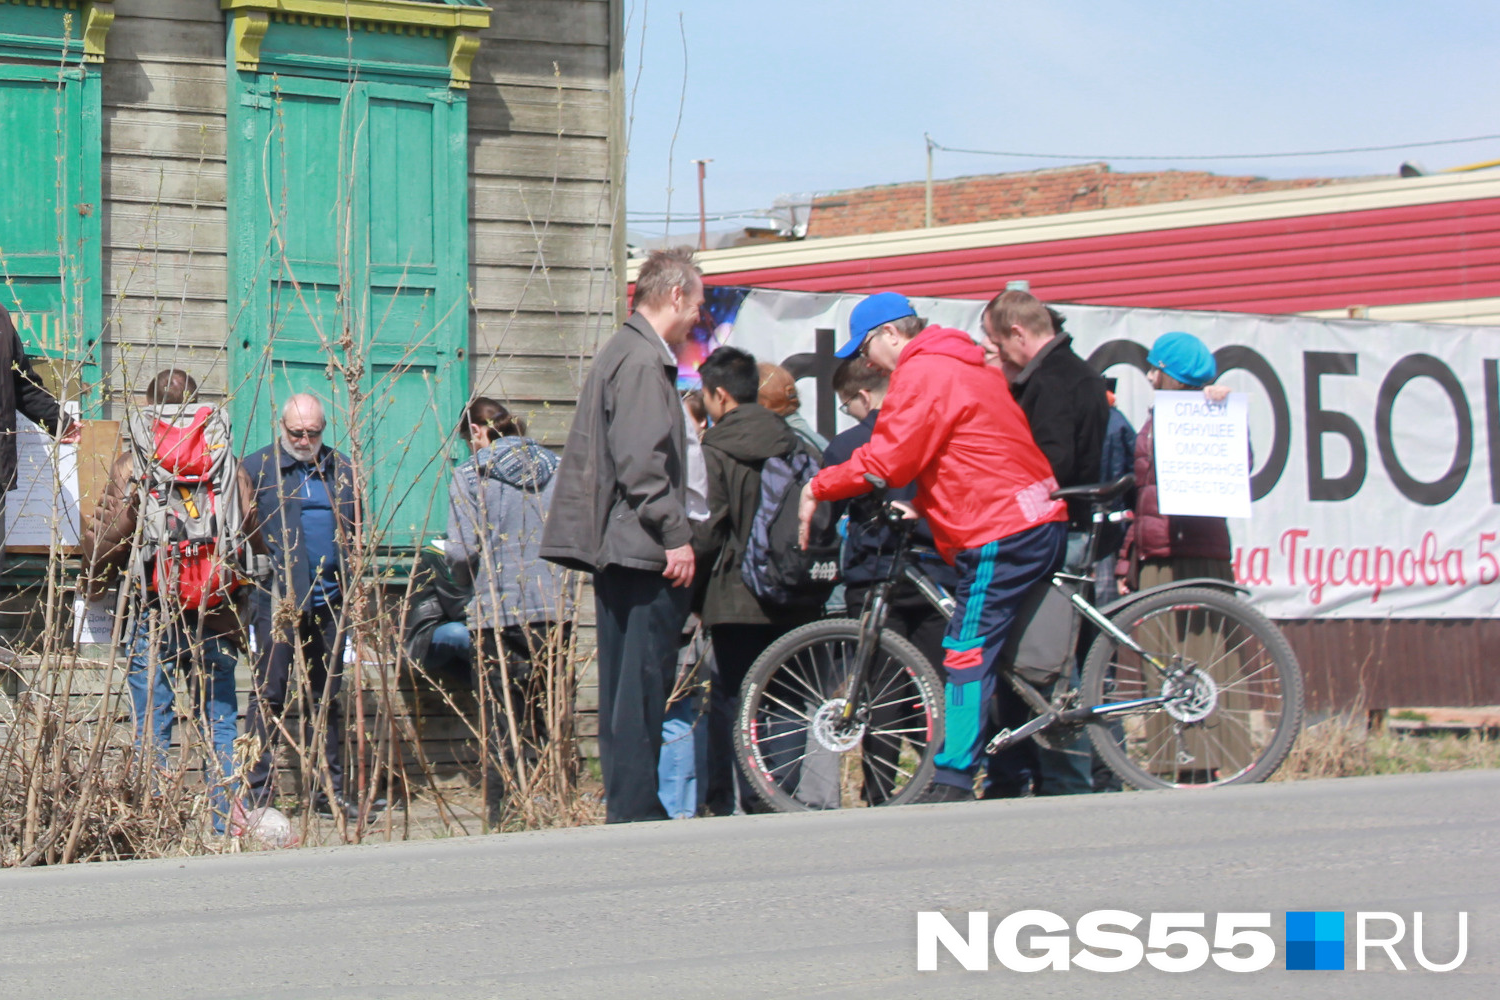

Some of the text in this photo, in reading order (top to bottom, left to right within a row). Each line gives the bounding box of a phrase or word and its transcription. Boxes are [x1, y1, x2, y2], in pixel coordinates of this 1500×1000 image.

[1167, 421, 1236, 438] ГИБНУЩЕЕ
[1175, 441, 1229, 457] ОМСКОЕ
[1160, 460, 1245, 477] ДЕРЕВЯННОЕ
[1279, 528, 1467, 605] Гусарова
